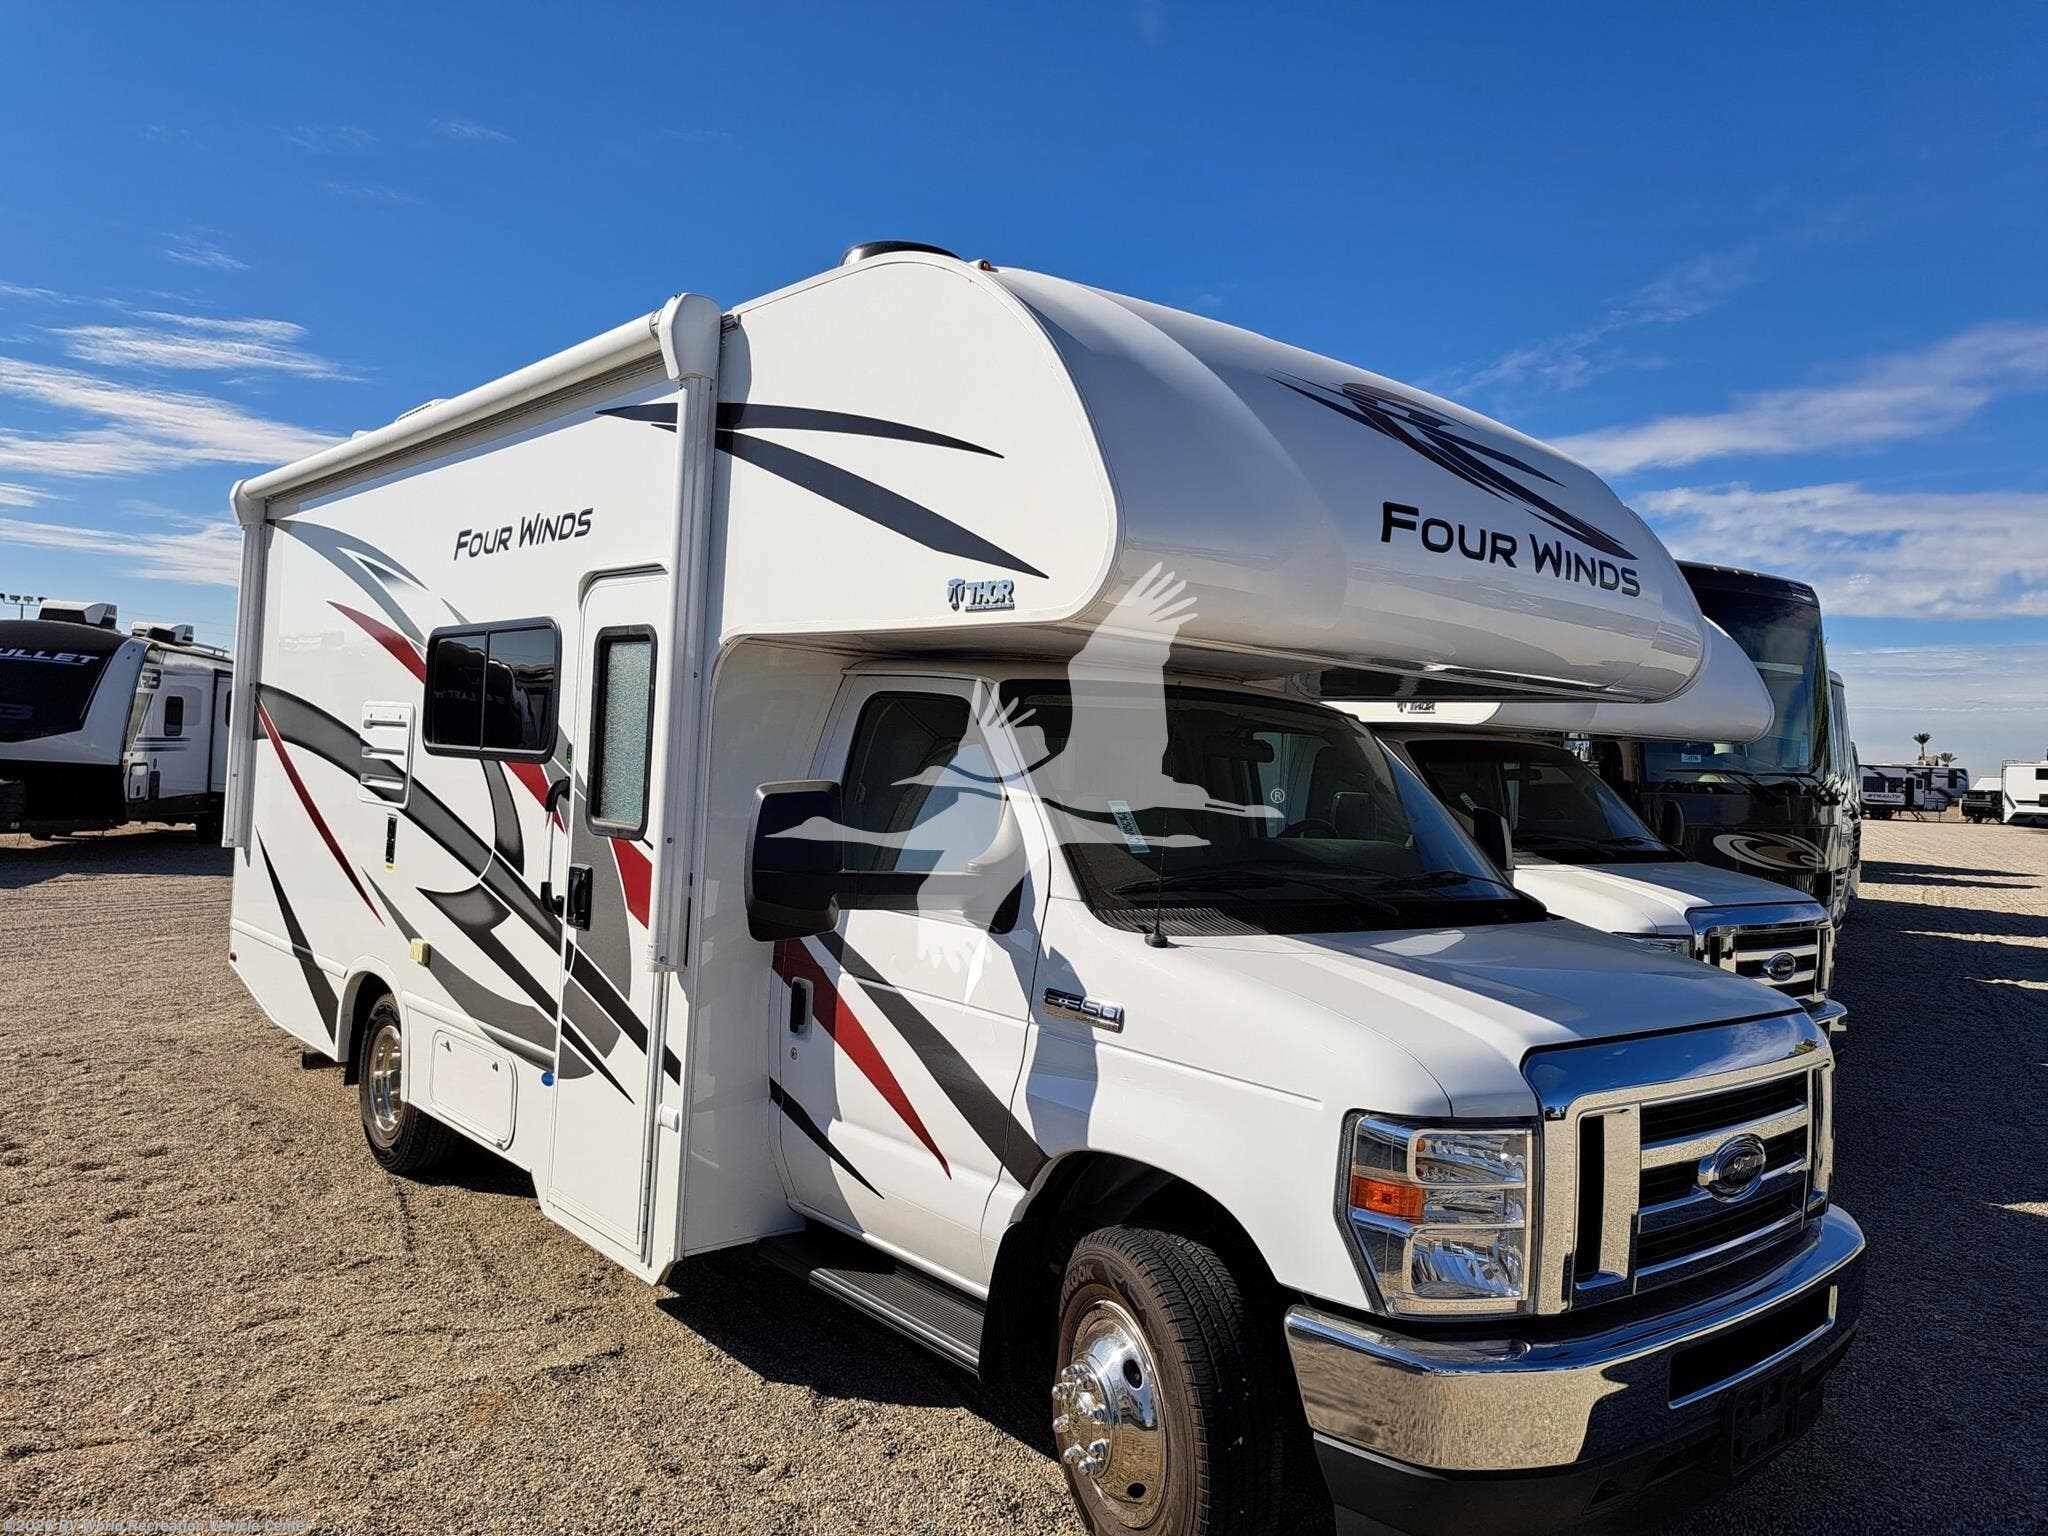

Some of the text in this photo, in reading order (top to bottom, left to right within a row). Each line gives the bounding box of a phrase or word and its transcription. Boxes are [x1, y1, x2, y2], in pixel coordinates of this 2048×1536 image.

[453, 507, 594, 561] FOUR WINDS
[1381, 501, 1641, 597] FOUR WINDS
[966, 579, 1015, 605] THOR
[0, 648, 100, 663] ULLET
